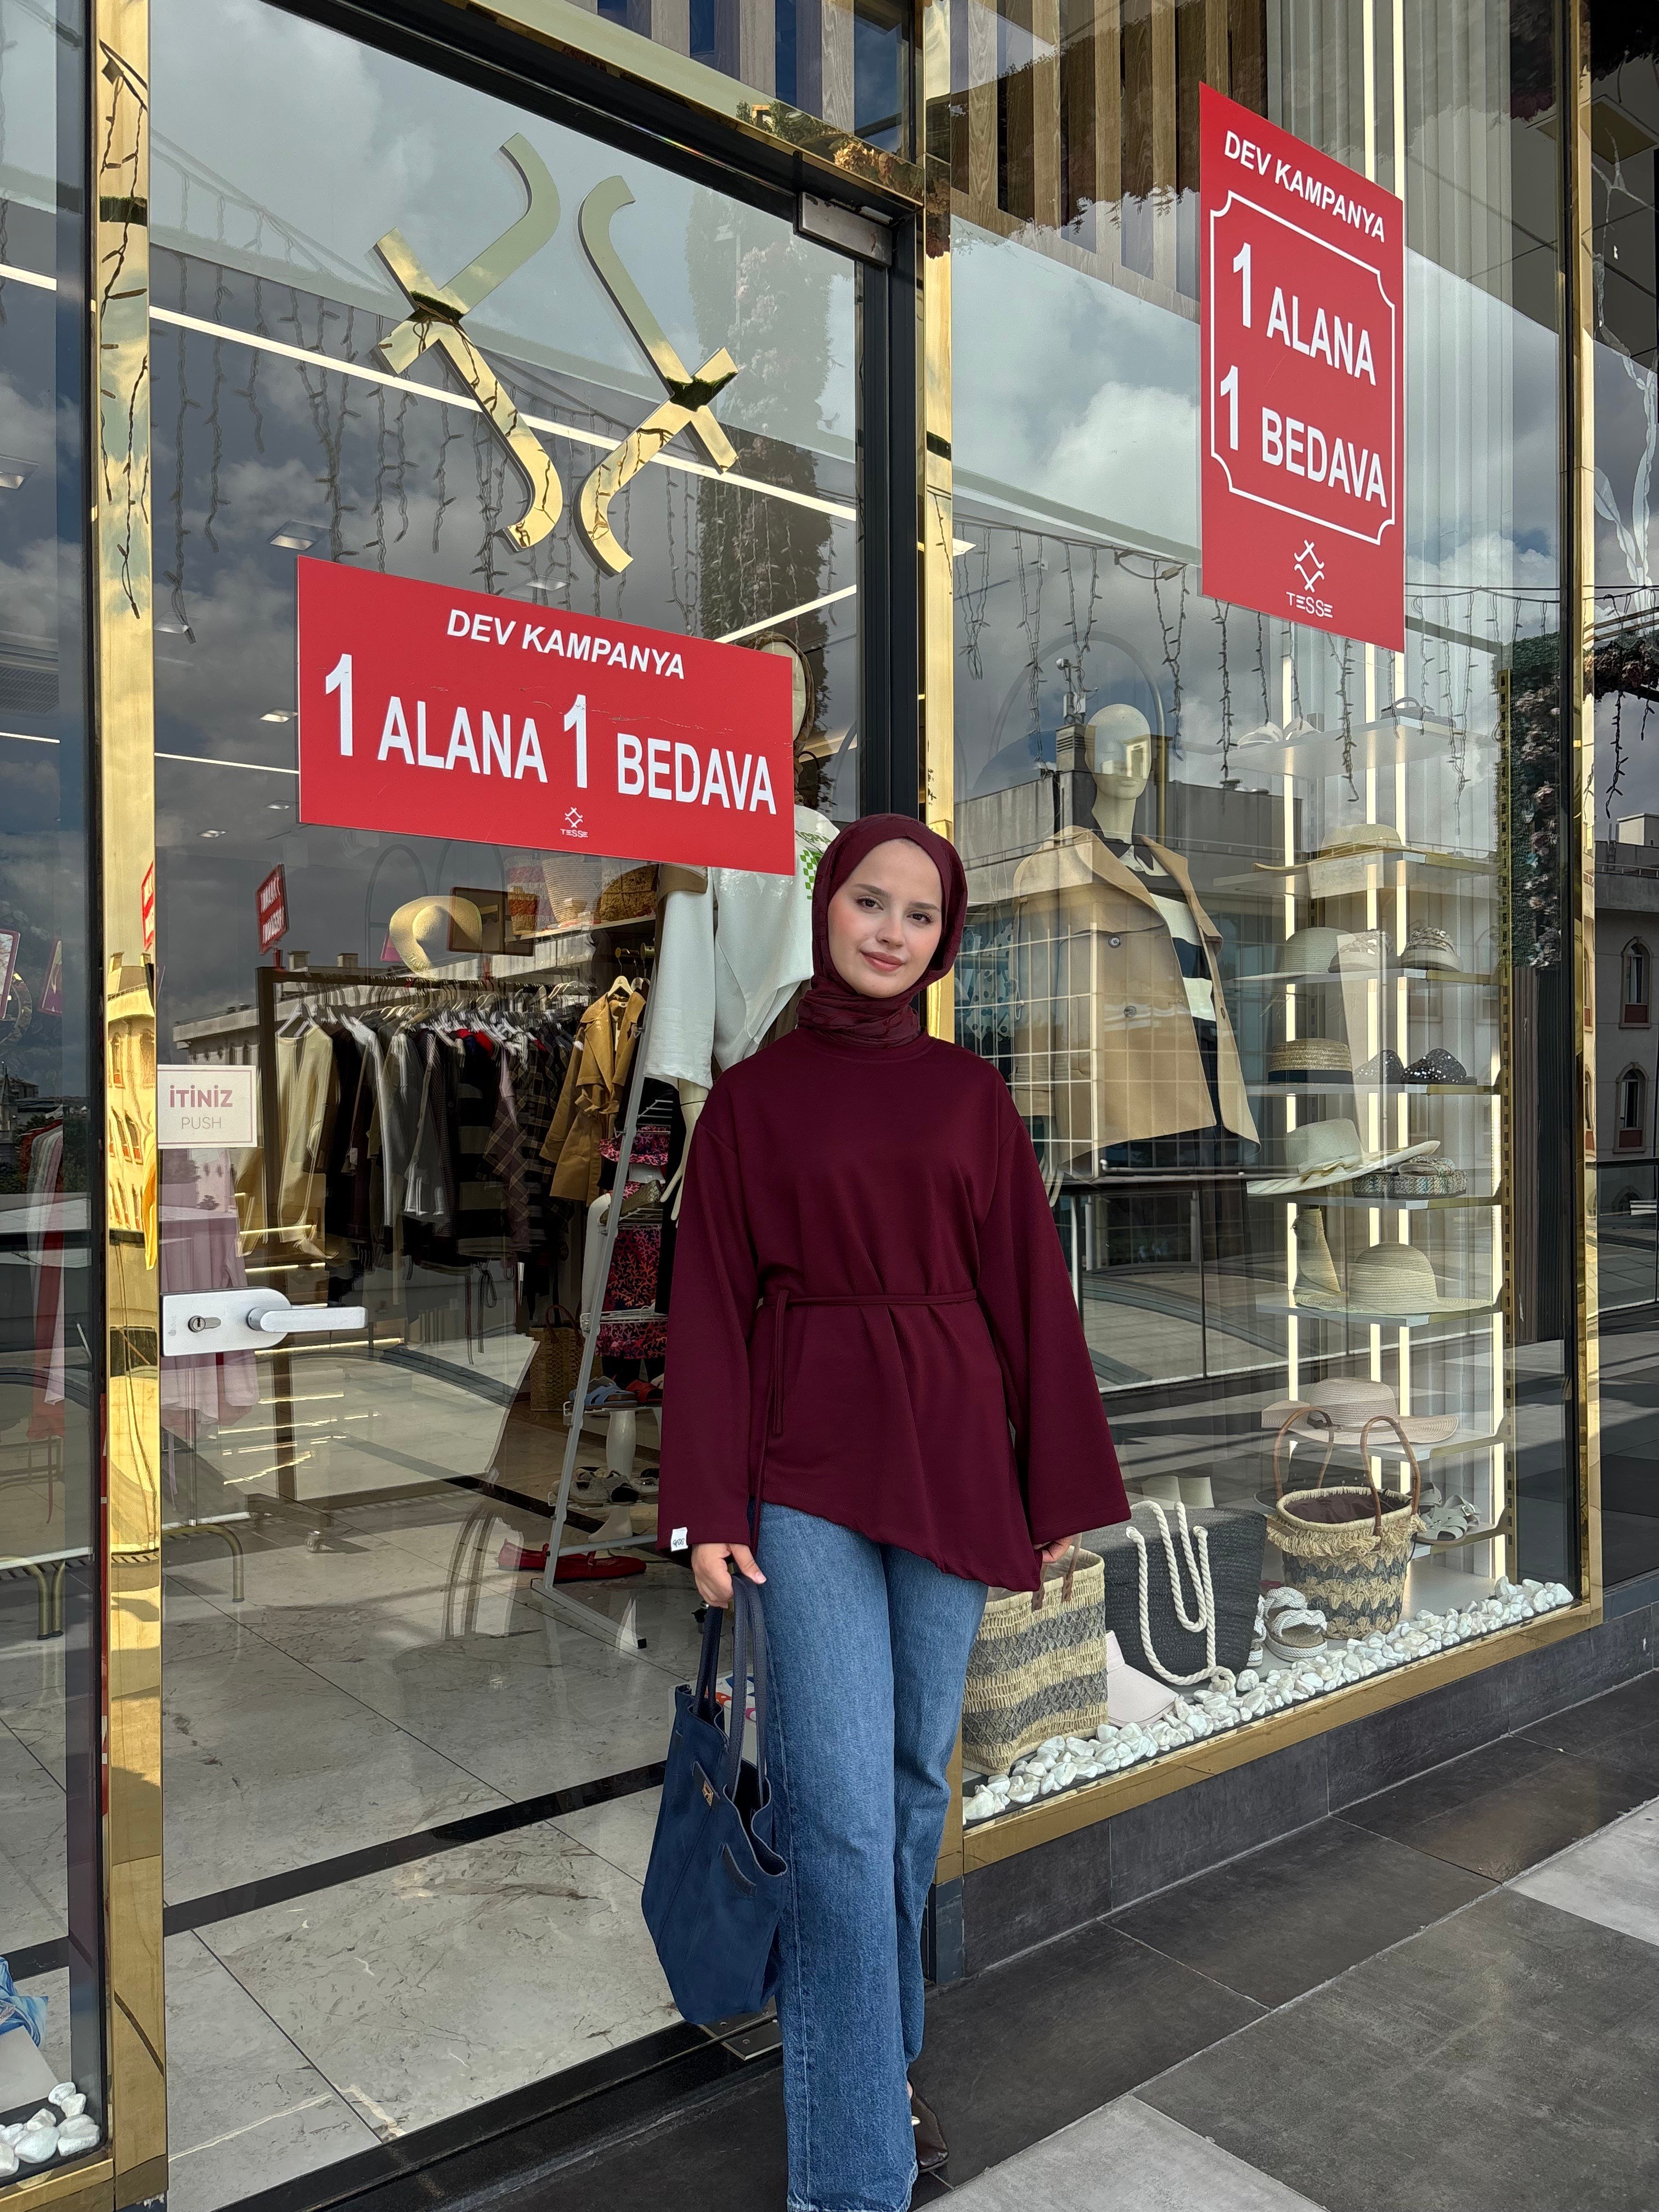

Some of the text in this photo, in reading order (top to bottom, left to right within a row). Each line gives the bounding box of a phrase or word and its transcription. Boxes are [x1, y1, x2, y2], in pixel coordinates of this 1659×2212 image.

[1224, 130, 1385, 243] DEV KAMPANYA
[1233, 242, 1376, 386] 1 ALANA
[1220, 365, 1387, 508] 1 BEDAVA
[1286, 591, 1333, 618] TESSE
[447, 609, 685, 680] DEV KAMPANYA
[325, 653, 777, 815] 1 ALANA 1 BEDAVA
[560, 828, 589, 838] TESSE
[170, 1084, 233, 1108] İTİNİZ
[182, 1116, 222, 1130] PUSH
